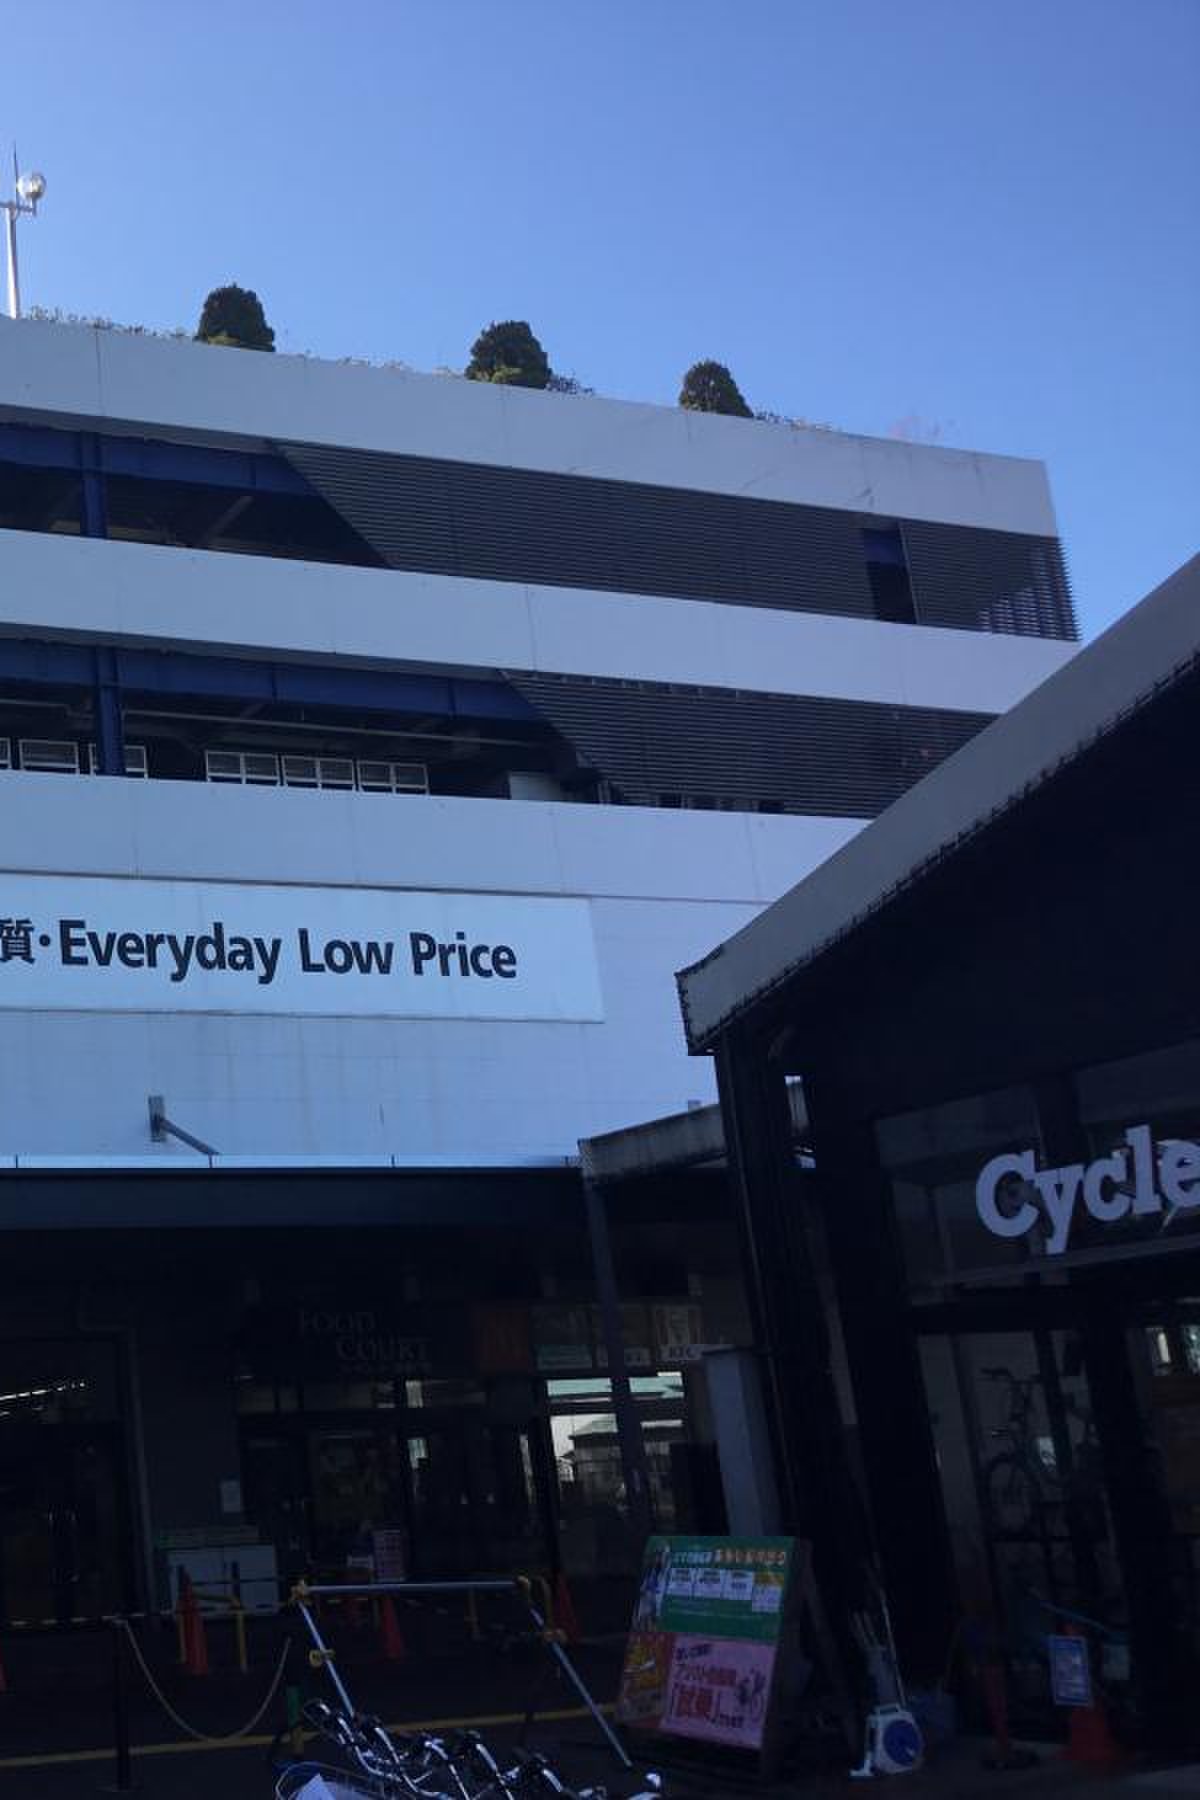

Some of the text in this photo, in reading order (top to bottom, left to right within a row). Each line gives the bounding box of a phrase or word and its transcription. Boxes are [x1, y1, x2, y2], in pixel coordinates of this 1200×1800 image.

[58, 919, 517, 985] Everyday Low Price
[975, 1122, 1200, 1256] Cycle
